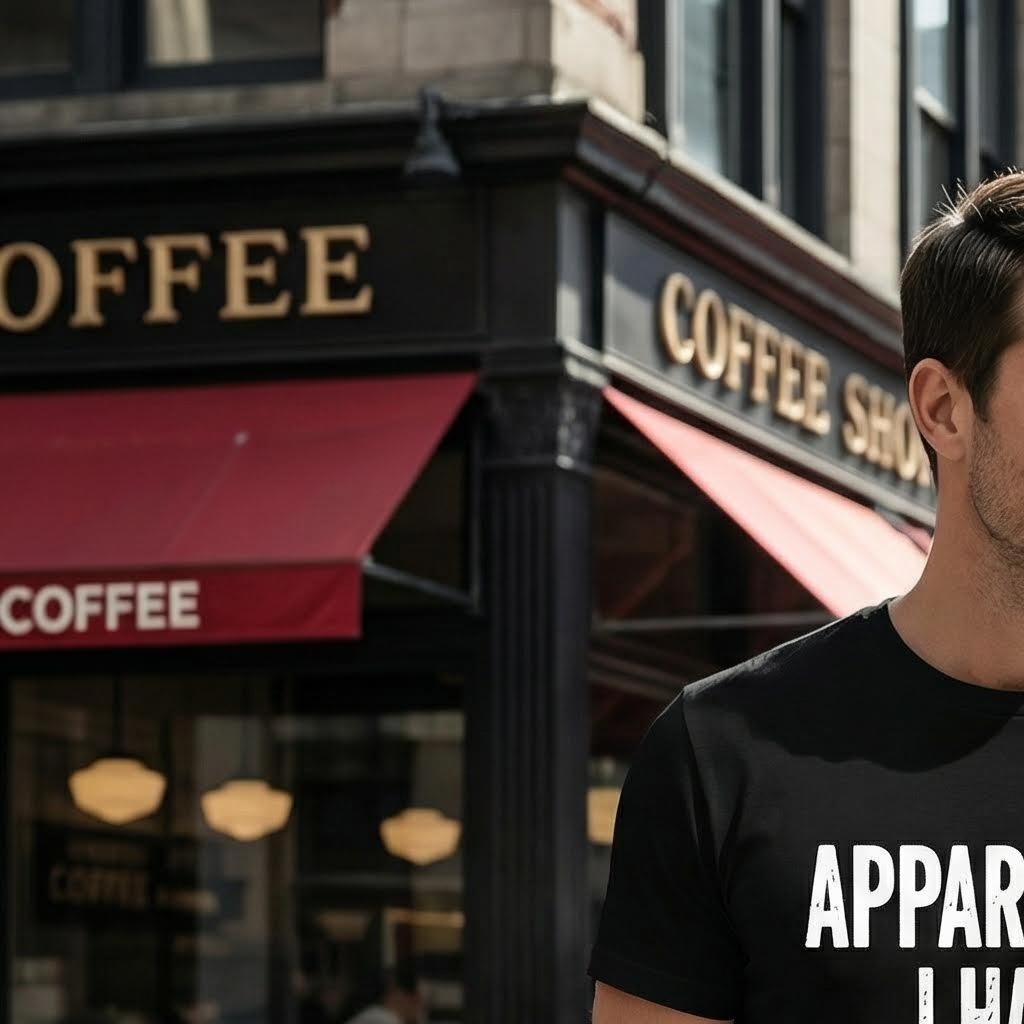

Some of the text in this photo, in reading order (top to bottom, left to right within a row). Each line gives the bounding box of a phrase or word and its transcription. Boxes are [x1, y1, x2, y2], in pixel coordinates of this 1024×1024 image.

[662, 271, 931, 488] COFFEE SHO
[0, 579, 200, 636] COFFEE
